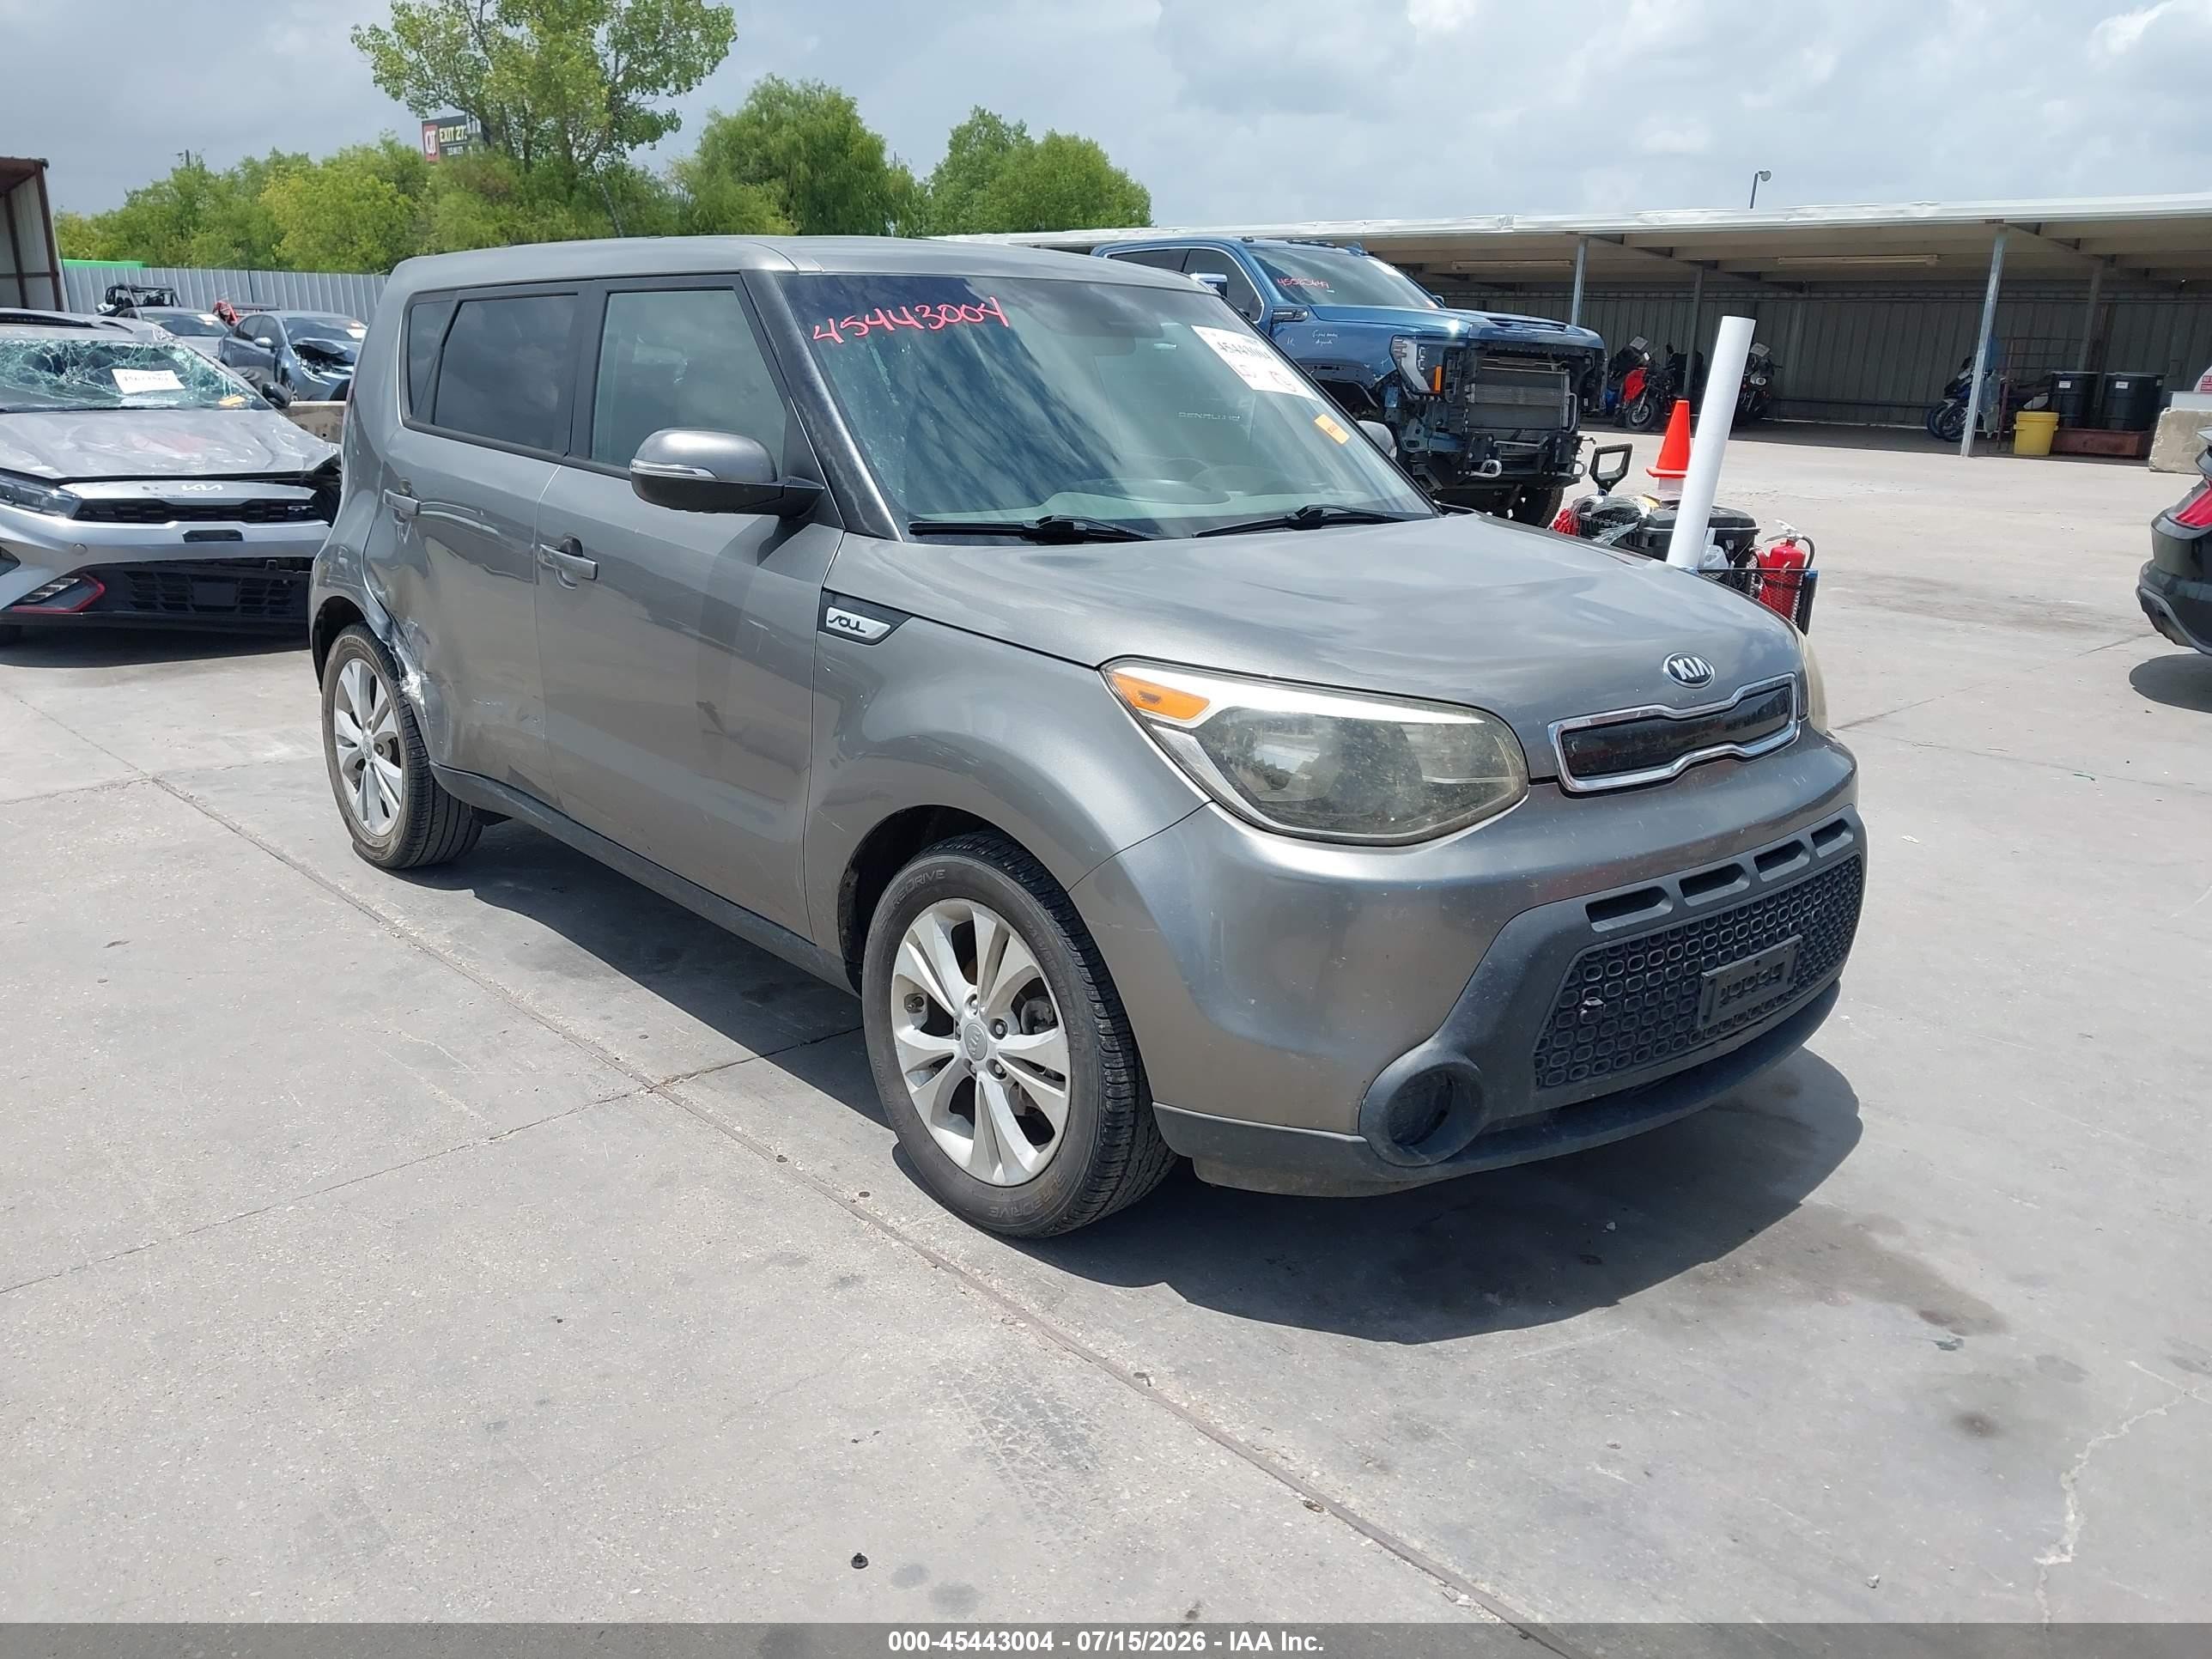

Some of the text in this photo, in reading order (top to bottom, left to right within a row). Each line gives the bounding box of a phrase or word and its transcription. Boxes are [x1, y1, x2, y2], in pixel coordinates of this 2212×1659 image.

[455, 125, 468, 141] 27
[812, 295, 1010, 344] 45443004
[827, 615, 866, 634] SOUL
[1668, 655, 1712, 681] KIA
